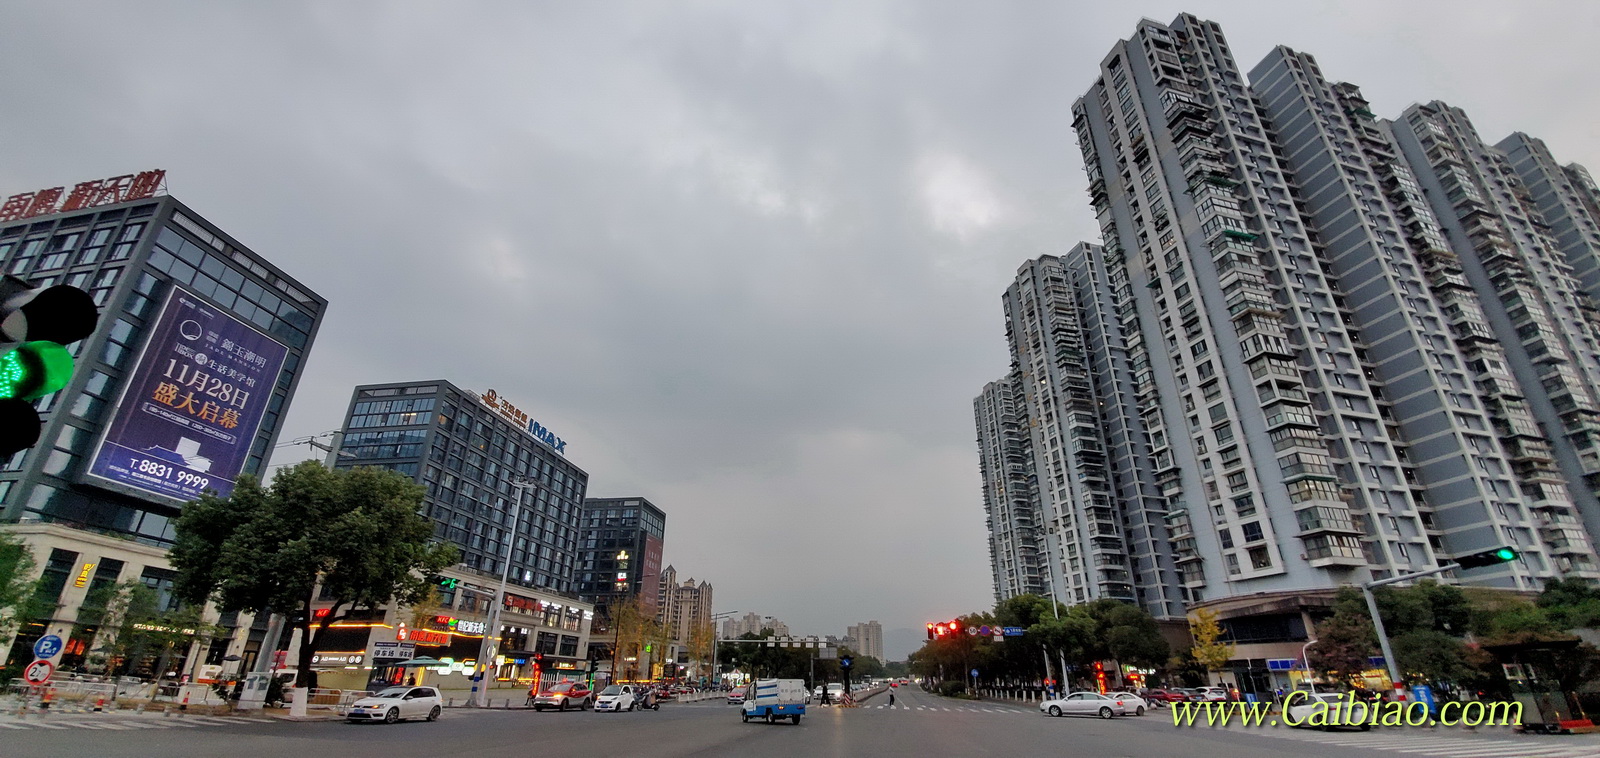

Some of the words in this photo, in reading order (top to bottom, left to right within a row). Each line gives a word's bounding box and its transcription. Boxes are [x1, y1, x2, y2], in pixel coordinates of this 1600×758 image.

[206, 359, 257, 388] 生活美学馆
[227, 354, 261, 372] MANSION
[163, 358, 250, 410] 11月28日
[151, 381, 242, 429] 盛大启幕
[528, 418, 568, 455] IMAX
[176, 471, 209, 490] 9999
[39, 641, 52, 653] P
[373, 649, 394, 657] 停车场
